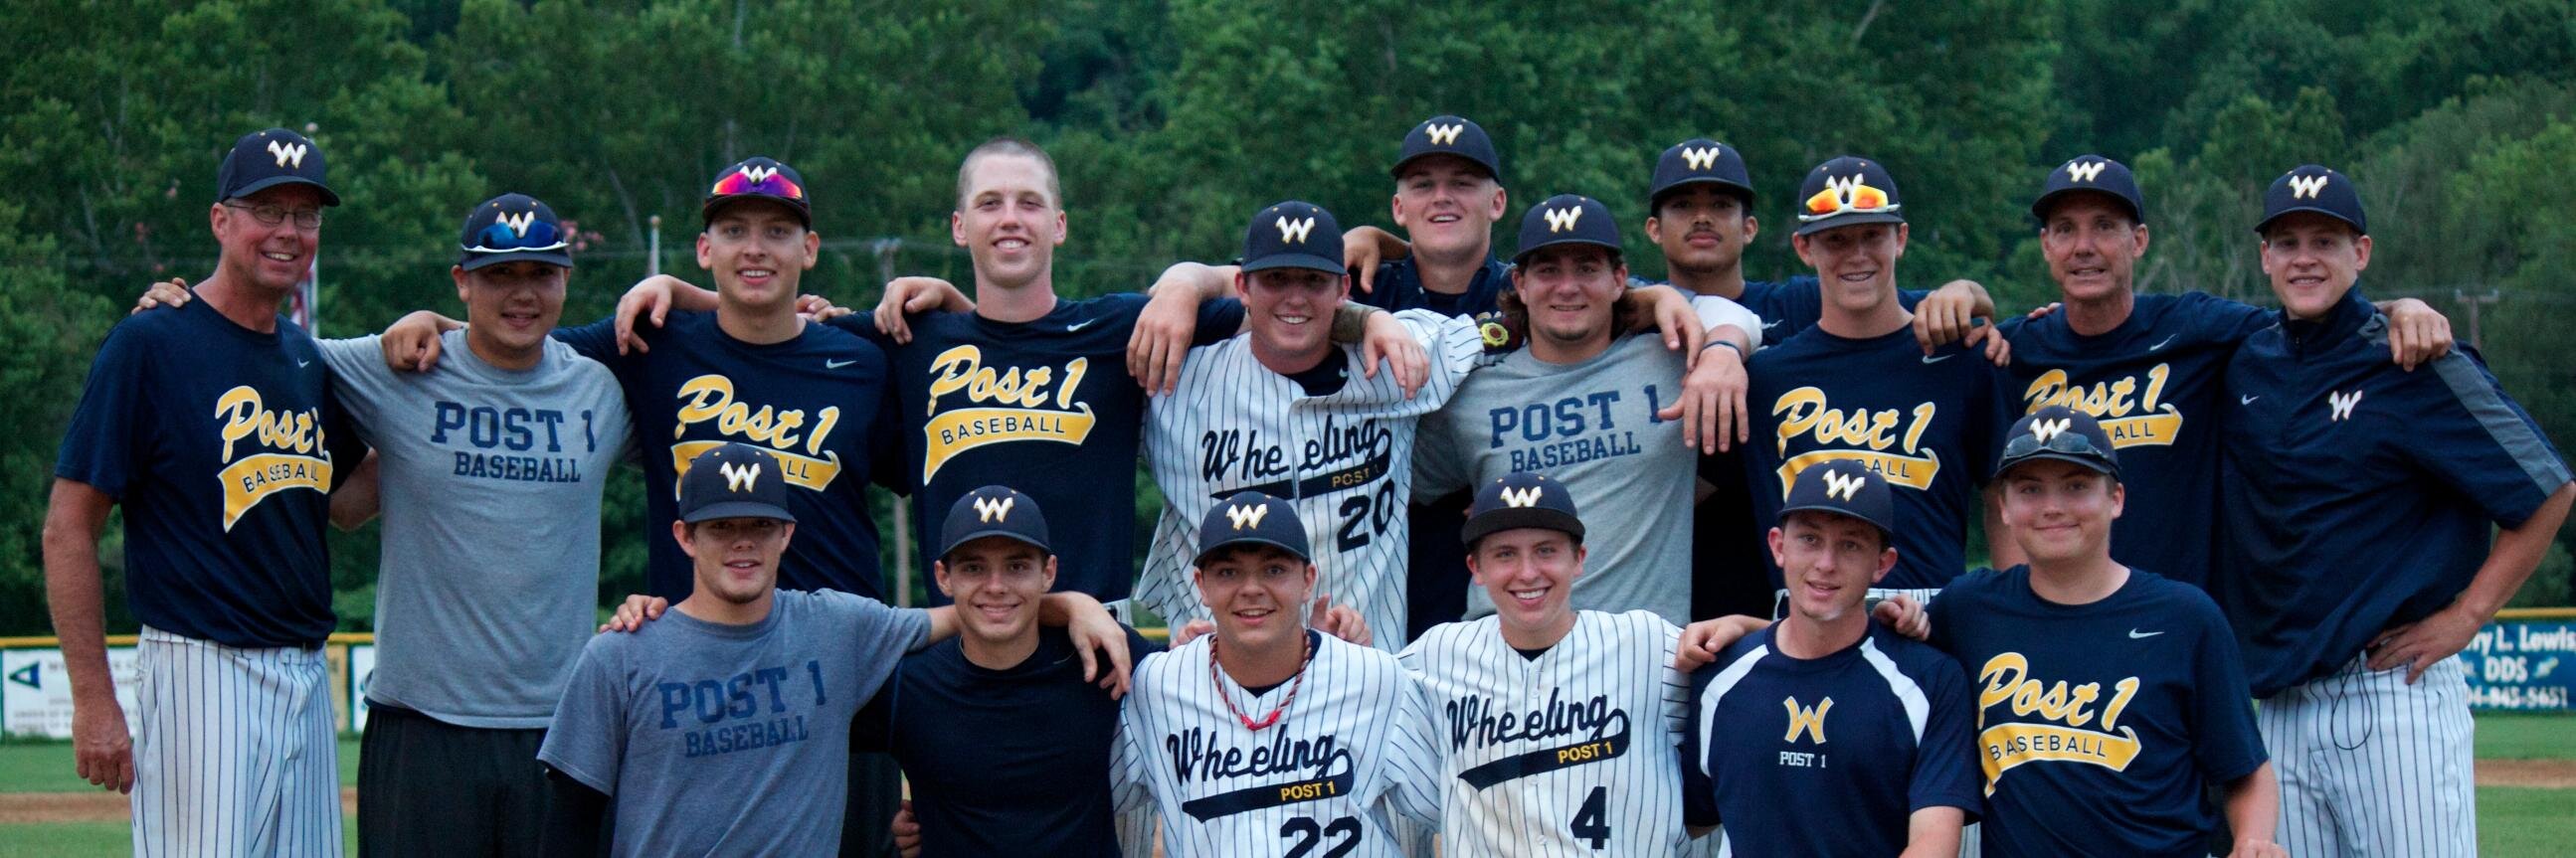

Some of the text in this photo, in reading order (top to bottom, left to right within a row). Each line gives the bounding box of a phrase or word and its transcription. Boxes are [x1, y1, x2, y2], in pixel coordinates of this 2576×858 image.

[1425, 123, 1463, 145] W
[267, 139, 308, 168] W
[1682, 146, 1720, 170] W
[2067, 161, 2106, 183] W
[2289, 174, 2328, 199] W
[1275, 216, 1316, 245] W
[1545, 205, 1582, 234] W
[927, 344, 1088, 418] Post 1
[2142, 362, 2170, 413] 1
[674, 374, 839, 456] Post 1
[1489, 384, 1664, 449] POST 1
[2329, 390, 2363, 422] W
[215, 385, 314, 464] Post
[431, 401, 596, 453] POST 1
[941, 417, 1065, 445] BASEBALL
[1772, 386, 1935, 460] Post 1
[1201, 414, 1378, 483] Wheeling
[1510, 430, 1641, 473] BASEBALL
[454, 451, 581, 483] BASEBALL
[719, 461, 761, 493] W
[1500, 485, 1543, 508] W
[1822, 469, 1866, 502] W
[973, 496, 1013, 524] W
[1225, 503, 1268, 531] W
[1337, 478, 1395, 554] 20
[2484, 655, 2529, 683] DDS
[656, 659, 827, 731] POST 1
[1977, 651, 2140, 733] Post 1
[1446, 686, 1608, 755] Wheeling
[1782, 695, 1834, 745] W
[684, 715, 809, 758] BASEBALL
[1558, 741, 1613, 764] POST 1
[1989, 735, 2107, 762] BASEBALL
[1166, 724, 1336, 786] Wheeling
[1779, 751, 1827, 769] POST 1
[1280, 780, 1336, 801] POST 1
[1570, 785, 1612, 850] 4
[1279, 815, 1363, 858] 22
